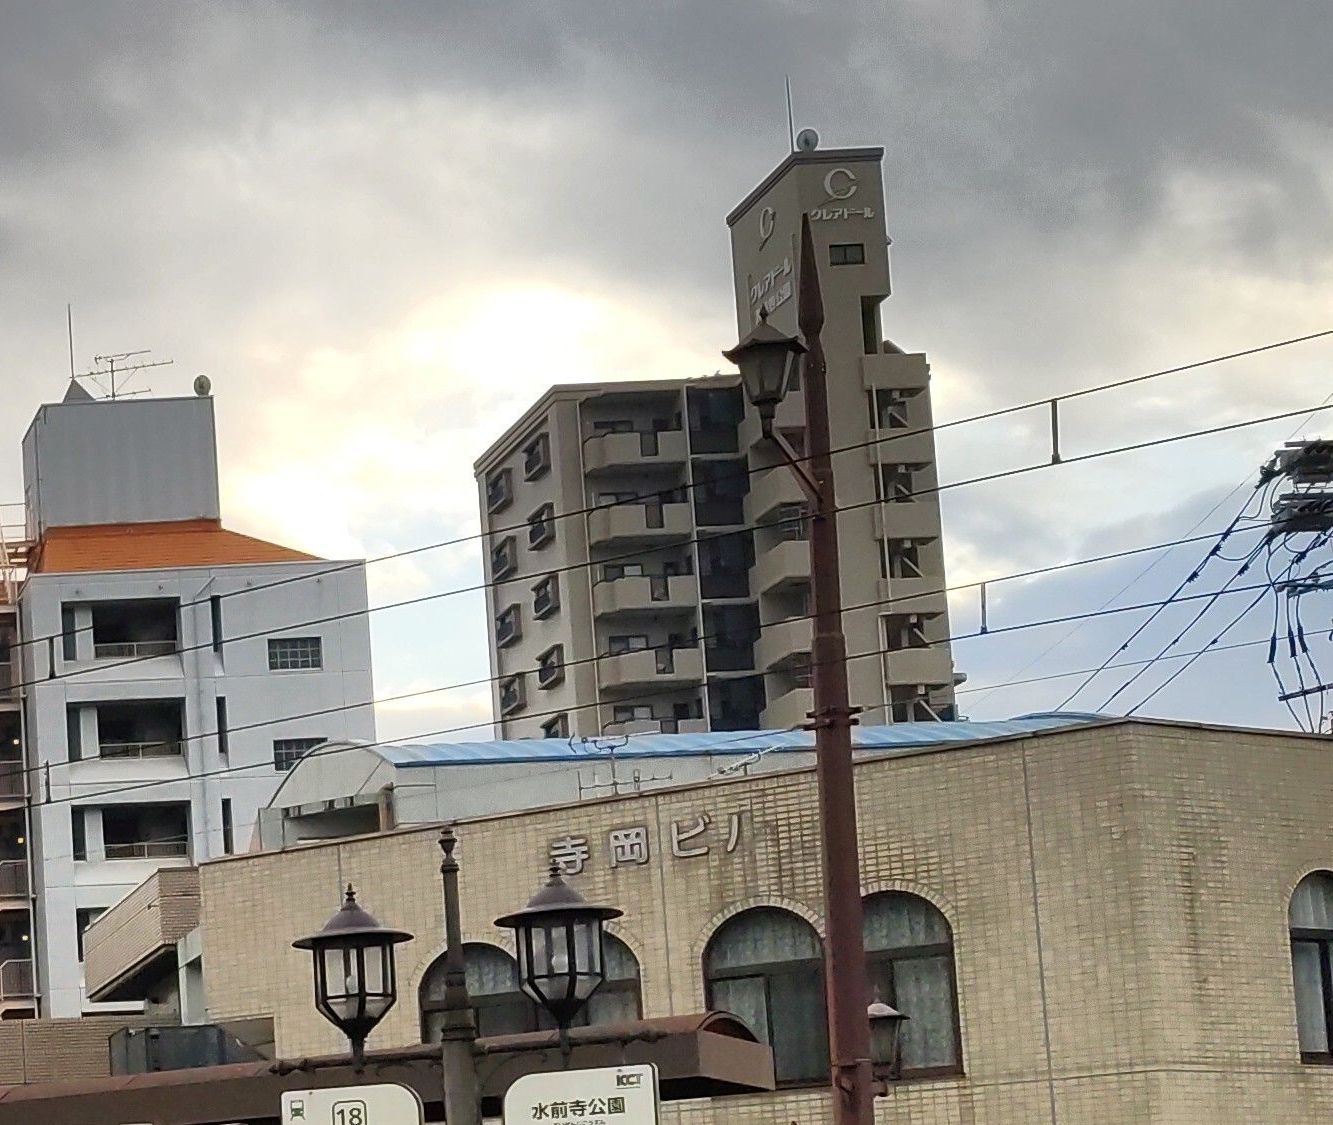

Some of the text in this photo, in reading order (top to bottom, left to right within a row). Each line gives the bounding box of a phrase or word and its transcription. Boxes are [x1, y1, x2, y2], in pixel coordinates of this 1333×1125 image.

[531, 1097, 626, 1120] 水前寺公園
